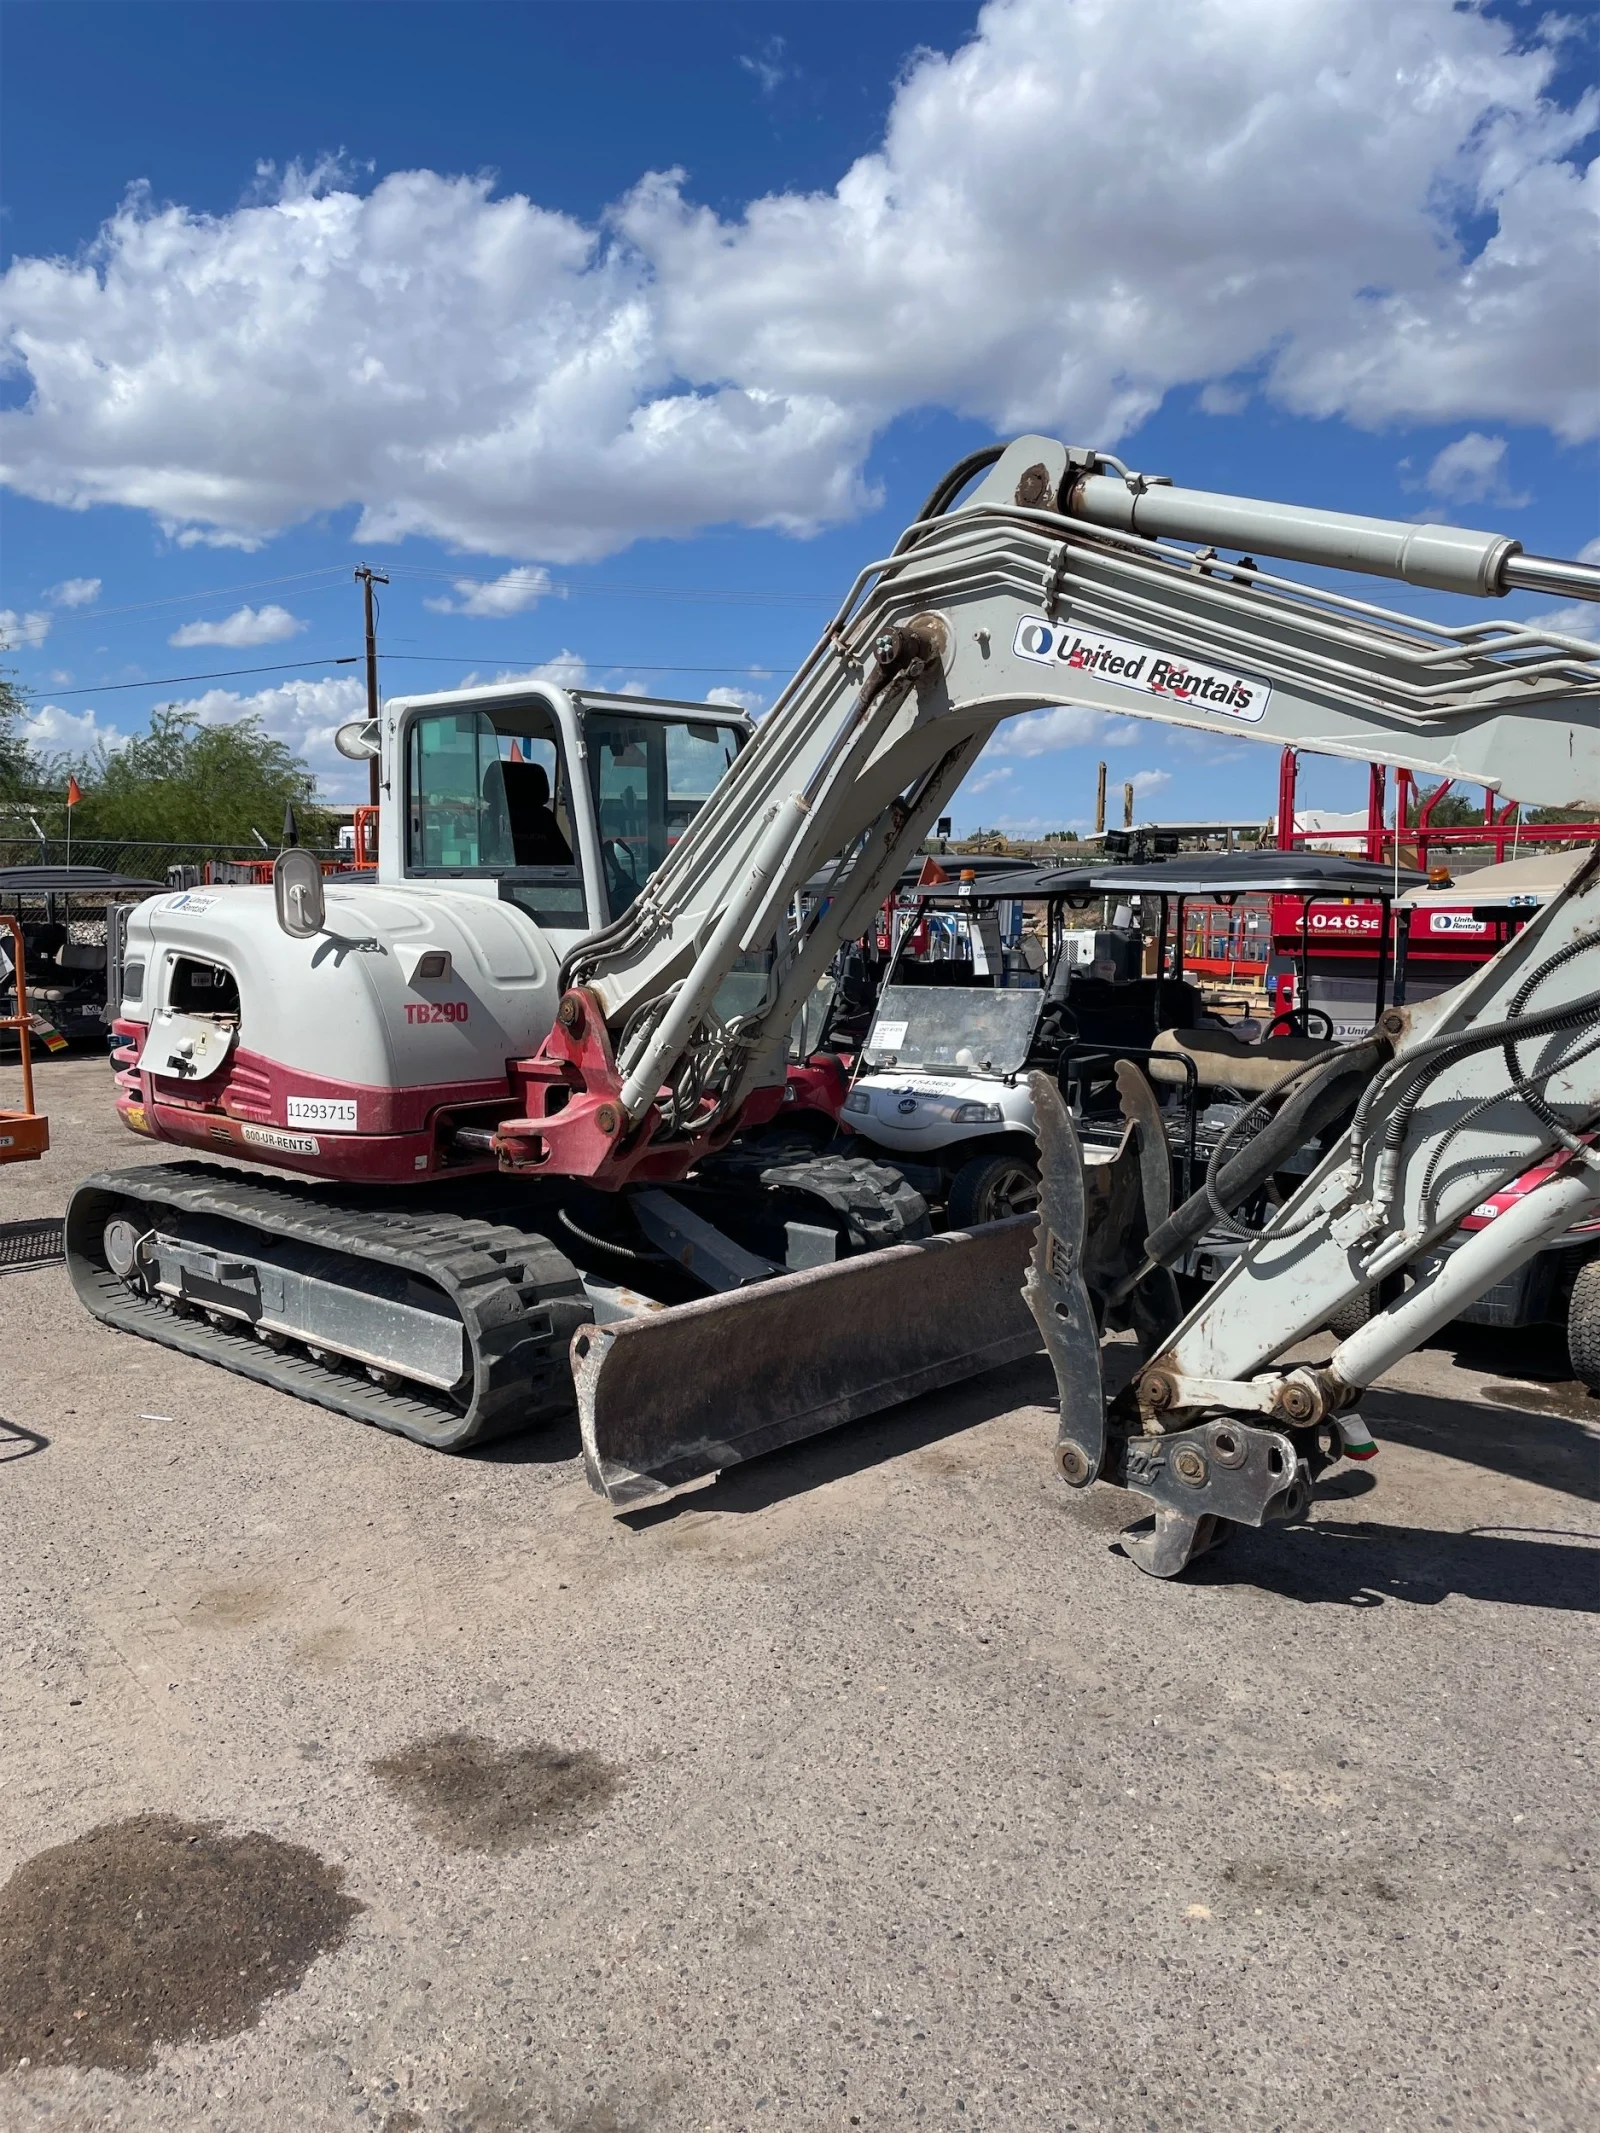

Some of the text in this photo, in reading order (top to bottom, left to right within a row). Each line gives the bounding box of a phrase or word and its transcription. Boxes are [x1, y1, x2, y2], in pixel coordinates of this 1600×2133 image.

[1056, 634, 1254, 710] United Rentals
[1452, 922, 1482, 930] Rentals
[403, 1001, 469, 1025] TB290
[288, 1102, 356, 1121] 11293715
[245, 1129, 313, 1151] 800-UR-RENTS
